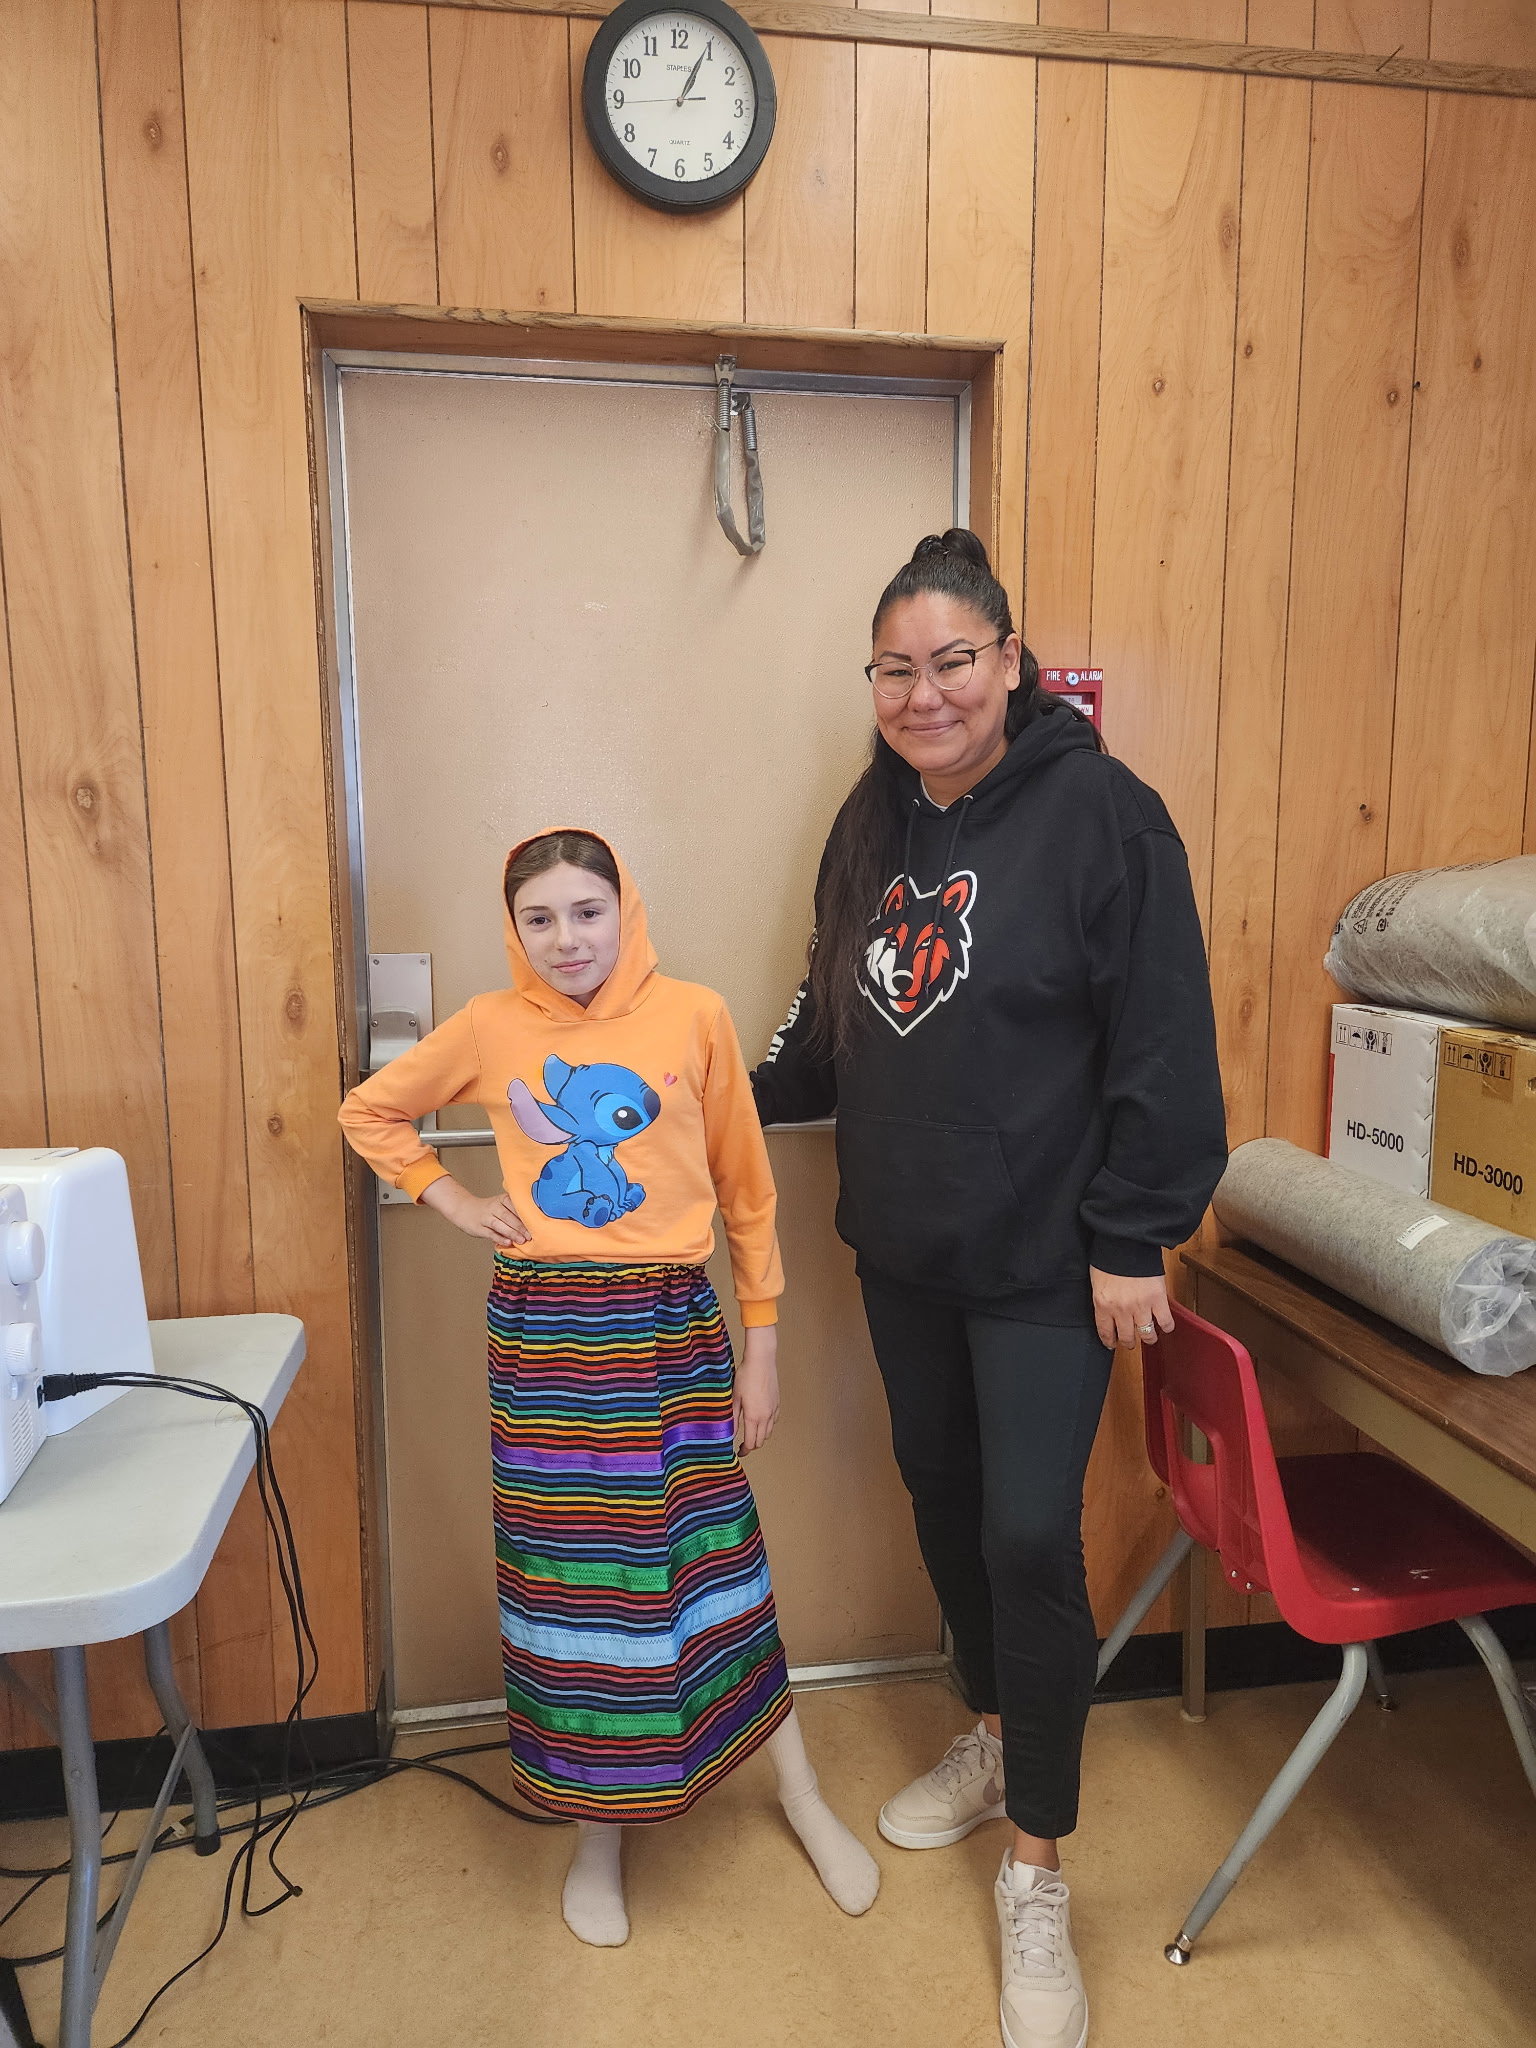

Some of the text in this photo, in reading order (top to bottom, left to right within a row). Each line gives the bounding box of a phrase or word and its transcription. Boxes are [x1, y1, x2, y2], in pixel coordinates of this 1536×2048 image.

[643, 35, 659, 57] 11
[670, 28, 689, 49] 12
[705, 40, 713, 62] 1
[622, 57, 641, 79] 10
[666, 64, 692, 72] STAPLES
[724, 66, 736, 86] 2
[613, 89, 625, 110] 9
[733, 98, 744, 118] 3
[624, 122, 636, 143] 8
[723, 130, 735, 150] 4
[647, 147, 658, 168] 7
[674, 158, 686, 178] 6
[704, 152, 714, 172] 5
[1046, 670, 1103, 681] FIRE ALARM
[1346, 1119, 1404, 1153] HD-5000
[1453, 1152, 1523, 1195] HD-3000
